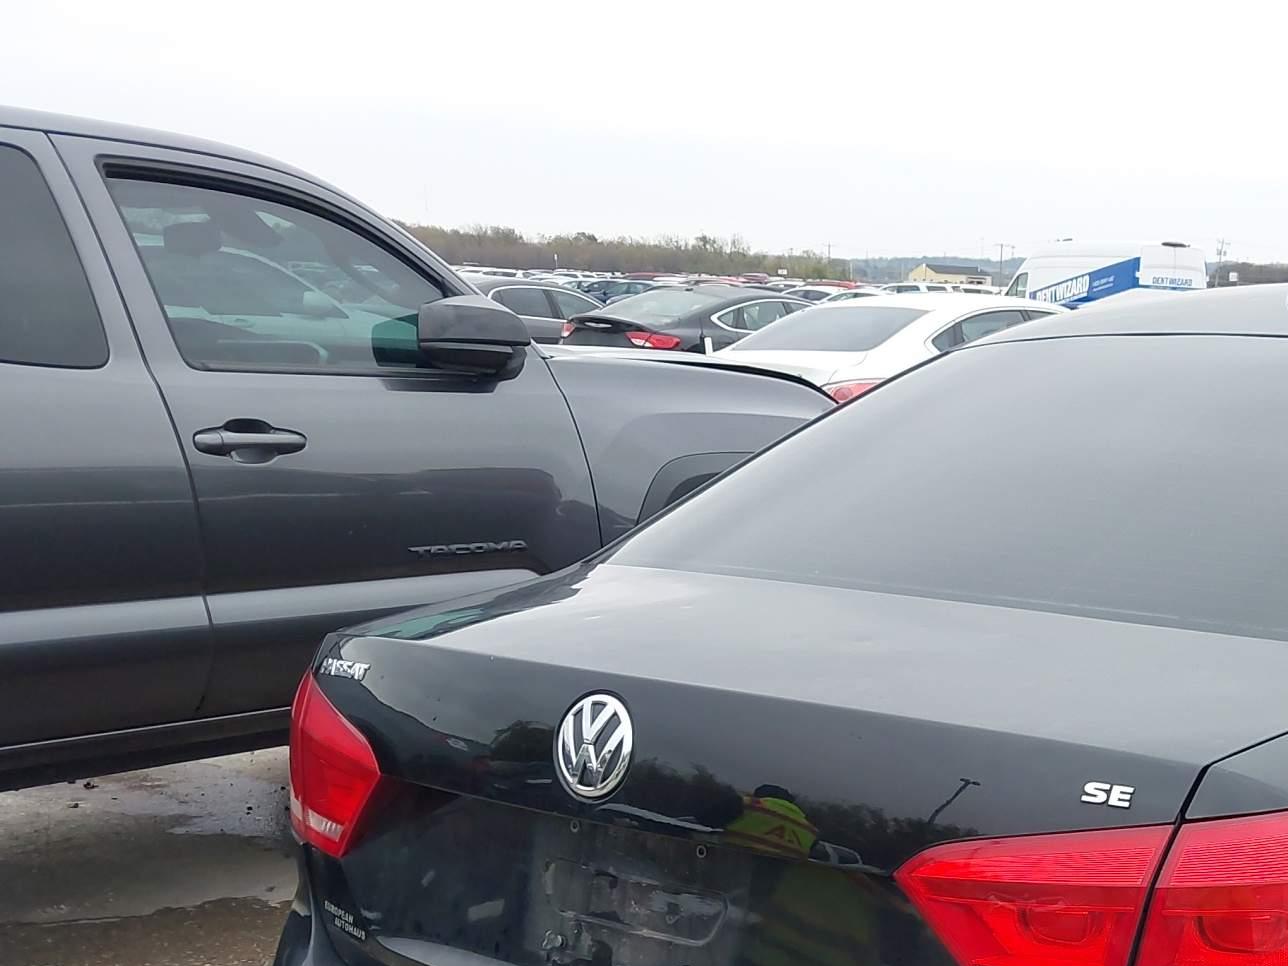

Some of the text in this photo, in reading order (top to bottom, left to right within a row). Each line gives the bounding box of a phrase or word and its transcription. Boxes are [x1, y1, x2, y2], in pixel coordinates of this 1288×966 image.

[408, 539, 529, 559] TACOMA
[319, 657, 371, 680] PASSAT
[1080, 781, 1135, 808] SE
